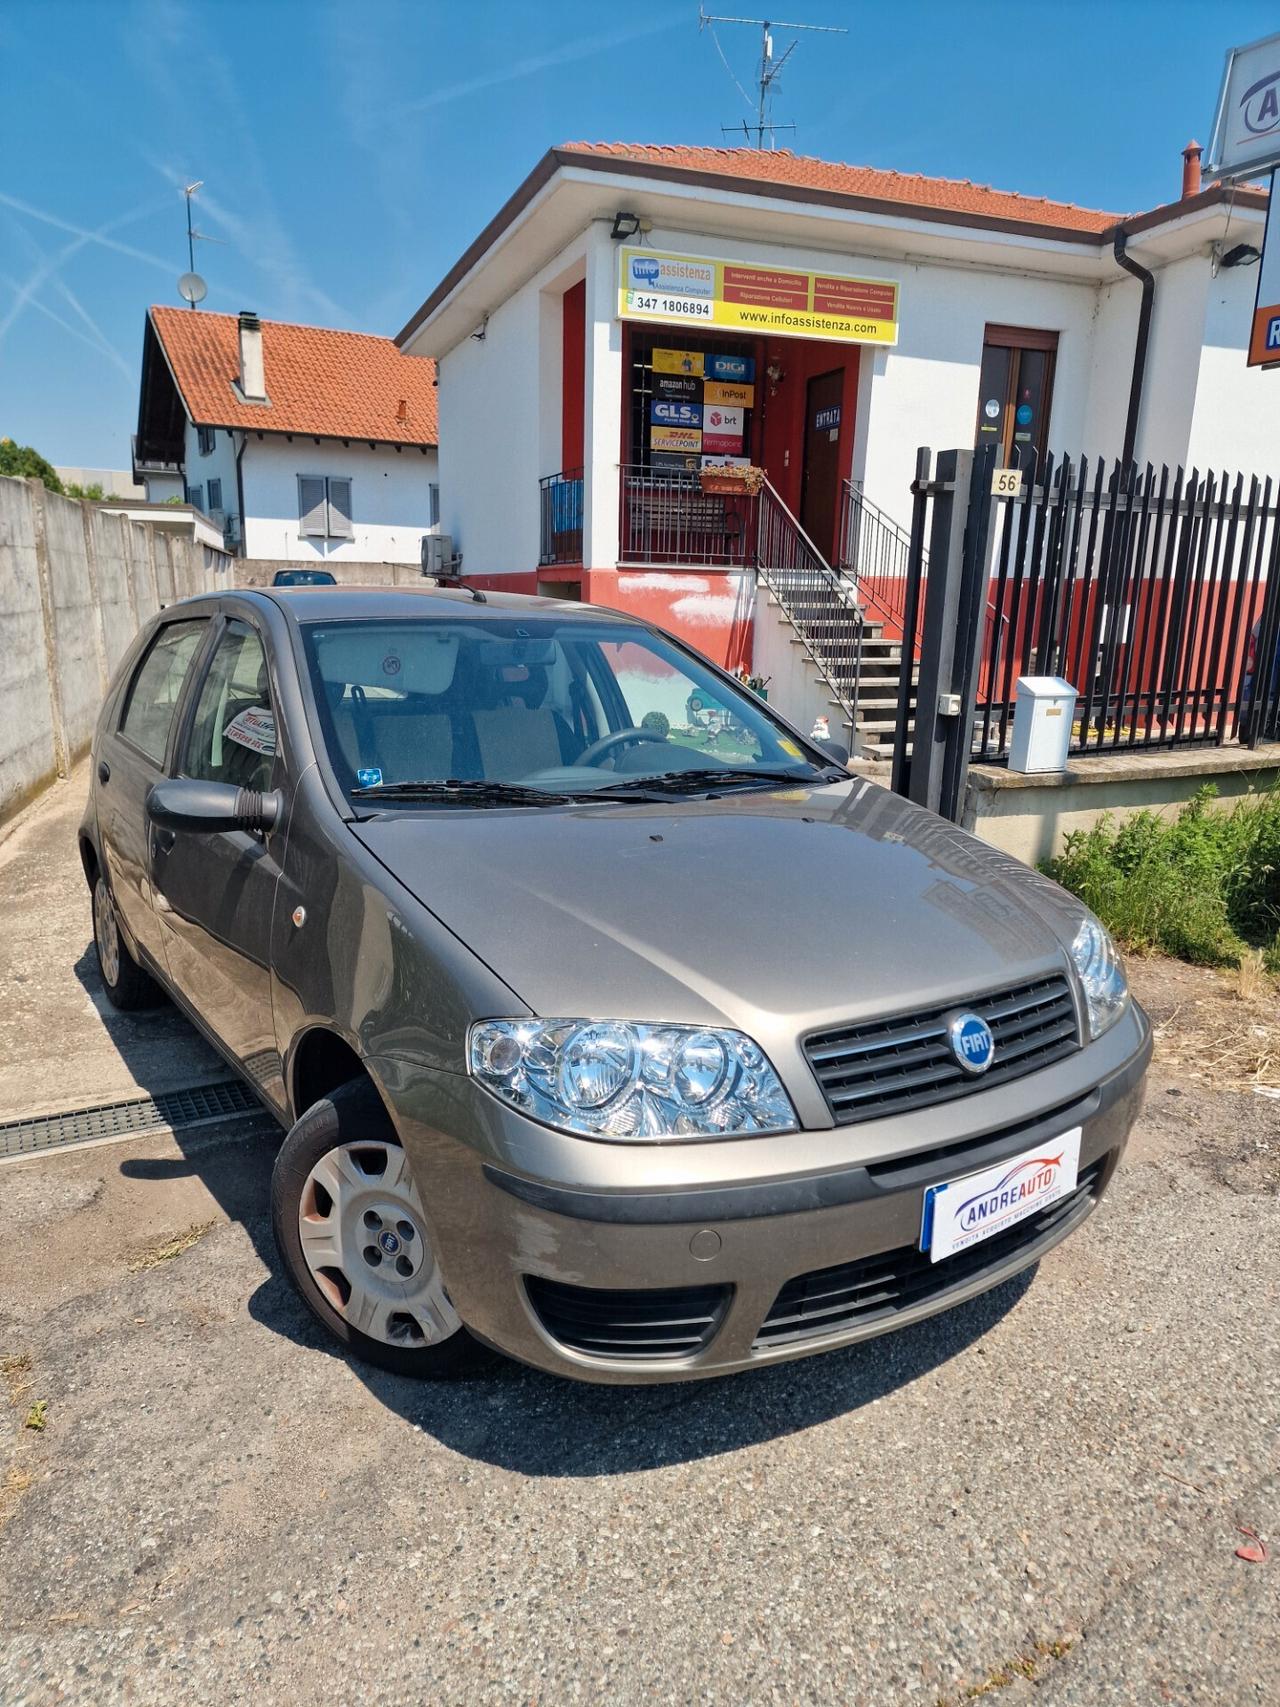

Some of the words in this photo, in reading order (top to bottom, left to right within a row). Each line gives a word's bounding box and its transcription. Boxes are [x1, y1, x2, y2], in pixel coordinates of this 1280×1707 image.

[757, 275, 773, 283] anche
[778, 277, 802, 286] Domicilio
[816, 282, 835, 290] Vendita
[840, 285, 869, 294] Riparazione
[740, 292, 770, 302] Riparazione
[638, 297, 657, 309] 347
[663, 300, 709, 315] 1806894
[827, 302, 845, 310] Vendita
[740, 311, 877, 334] www.infoassistenza.com
[715, 361, 745, 372] DIGI
[660, 379, 682, 390] amazon
[683, 380, 696, 391] hub
[722, 389, 746, 399] InPost
[654, 404, 692, 418] GLS
[724, 415, 737, 425] brt
[816, 407, 840, 428] ENTRATA
[669, 431, 695, 440] DHL
[998, 474, 1017, 491] 56
[961, 1032, 991, 1055] FIAT
[967, 1169, 1052, 1225] ANDREAUTO
